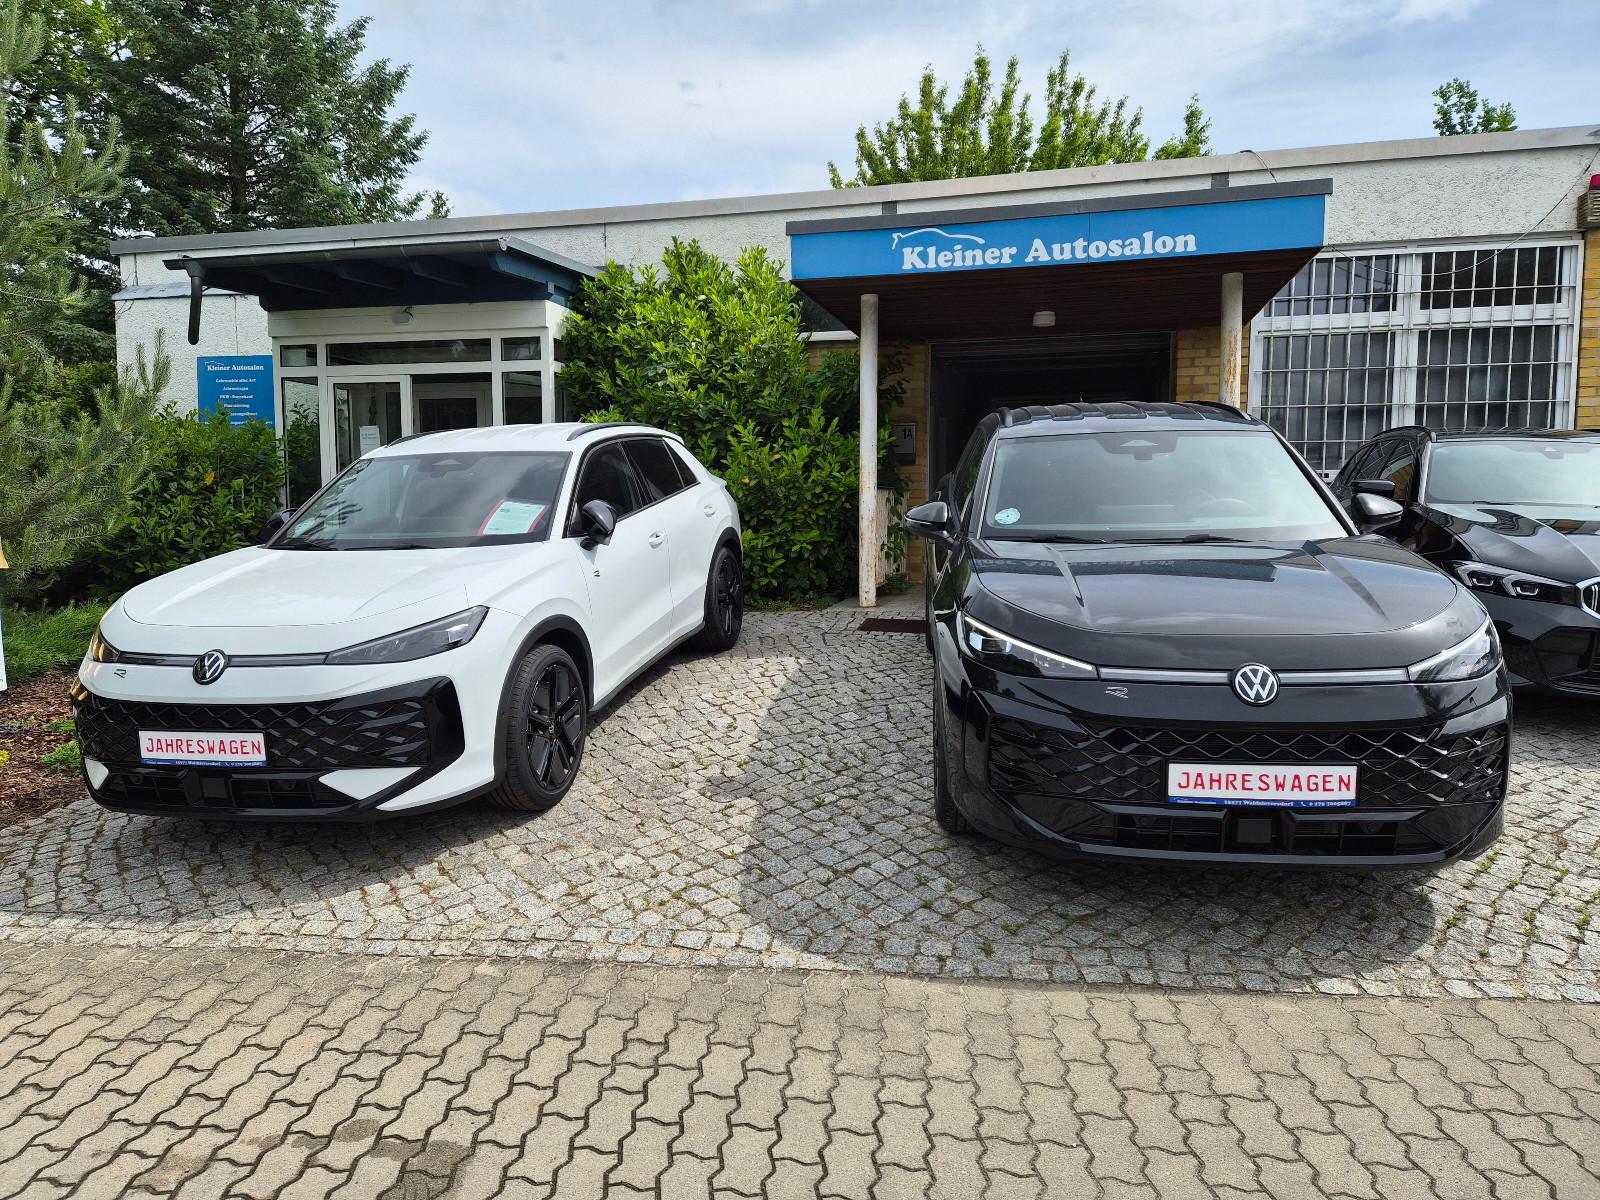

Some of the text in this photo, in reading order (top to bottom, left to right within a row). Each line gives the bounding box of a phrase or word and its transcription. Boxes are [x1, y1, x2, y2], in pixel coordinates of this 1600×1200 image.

[902, 230, 1197, 270] Kleiner Autosalon
[902, 427, 913, 440] 1A
[1235, 665, 1277, 703] VW
[147, 738, 261, 755] JAHRESWAGEN
[1178, 772, 1351, 792] JAHRESWAGEN
